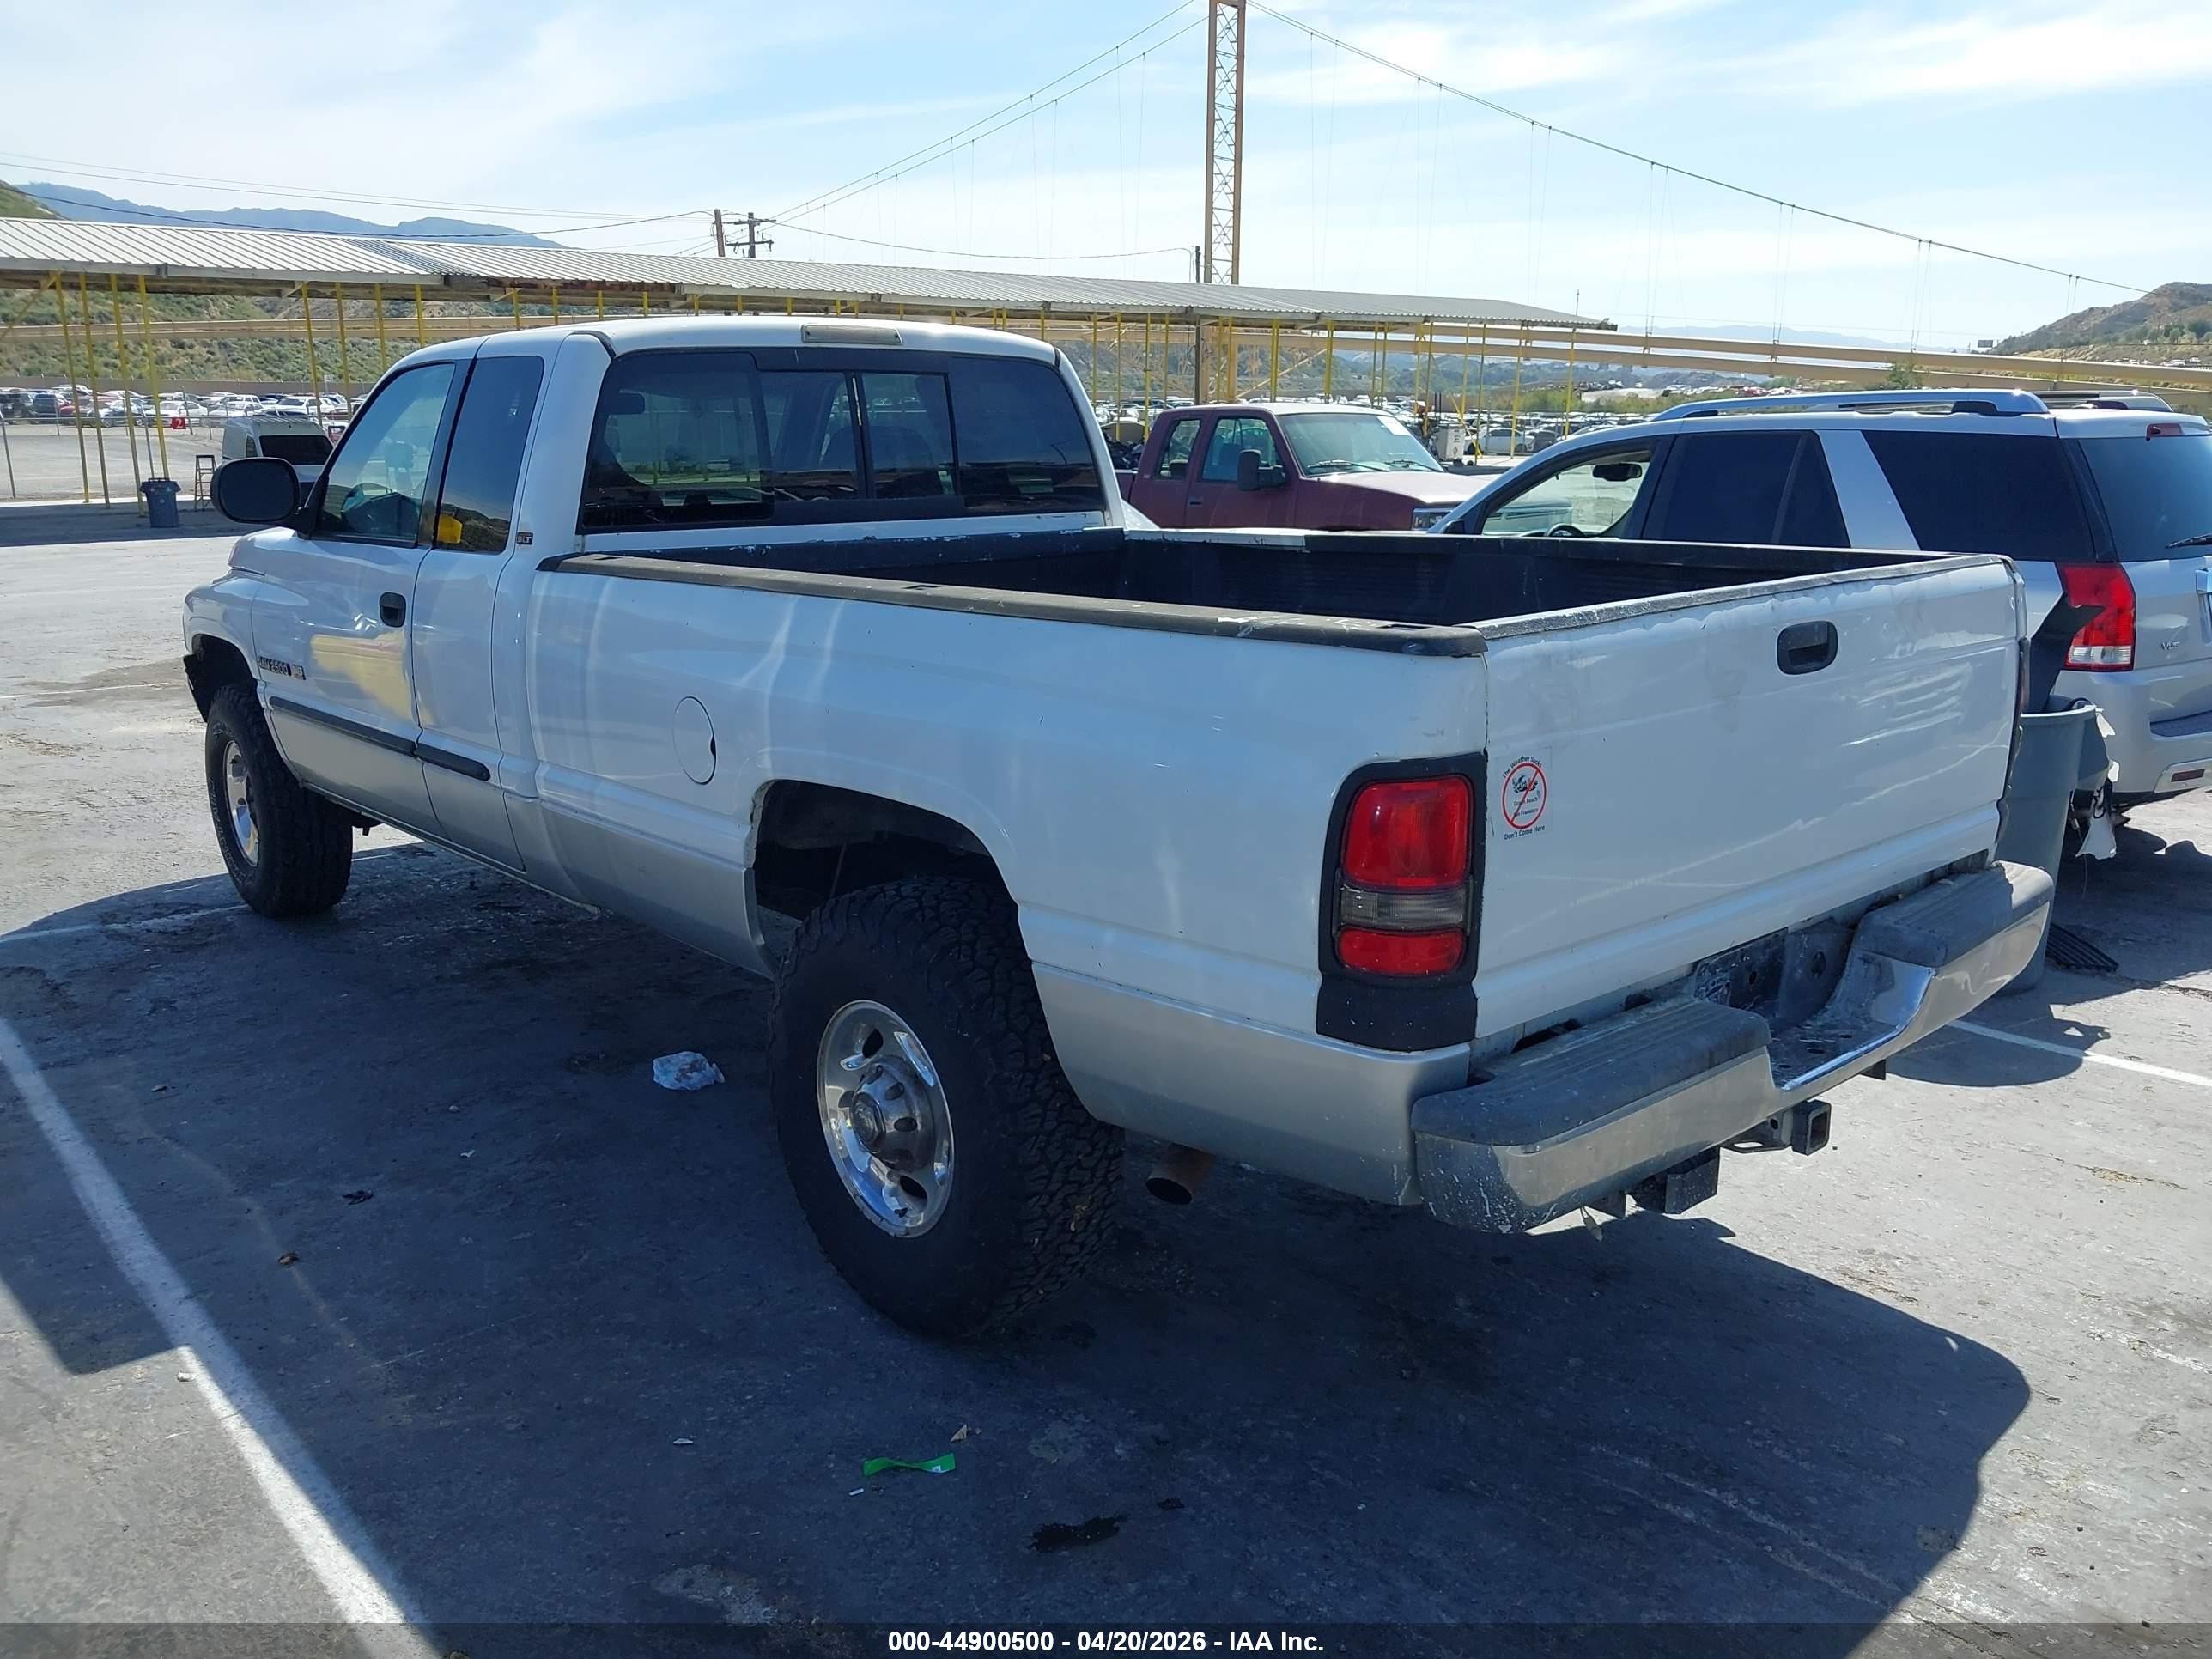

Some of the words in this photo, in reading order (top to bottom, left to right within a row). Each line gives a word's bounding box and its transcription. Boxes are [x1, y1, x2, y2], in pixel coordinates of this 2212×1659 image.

[1510, 756, 1530, 768] Weather
[1531, 757, 1542, 768] Sucks
[1504, 830, 1517, 840] Don't
[1519, 828, 1533, 836] Come
